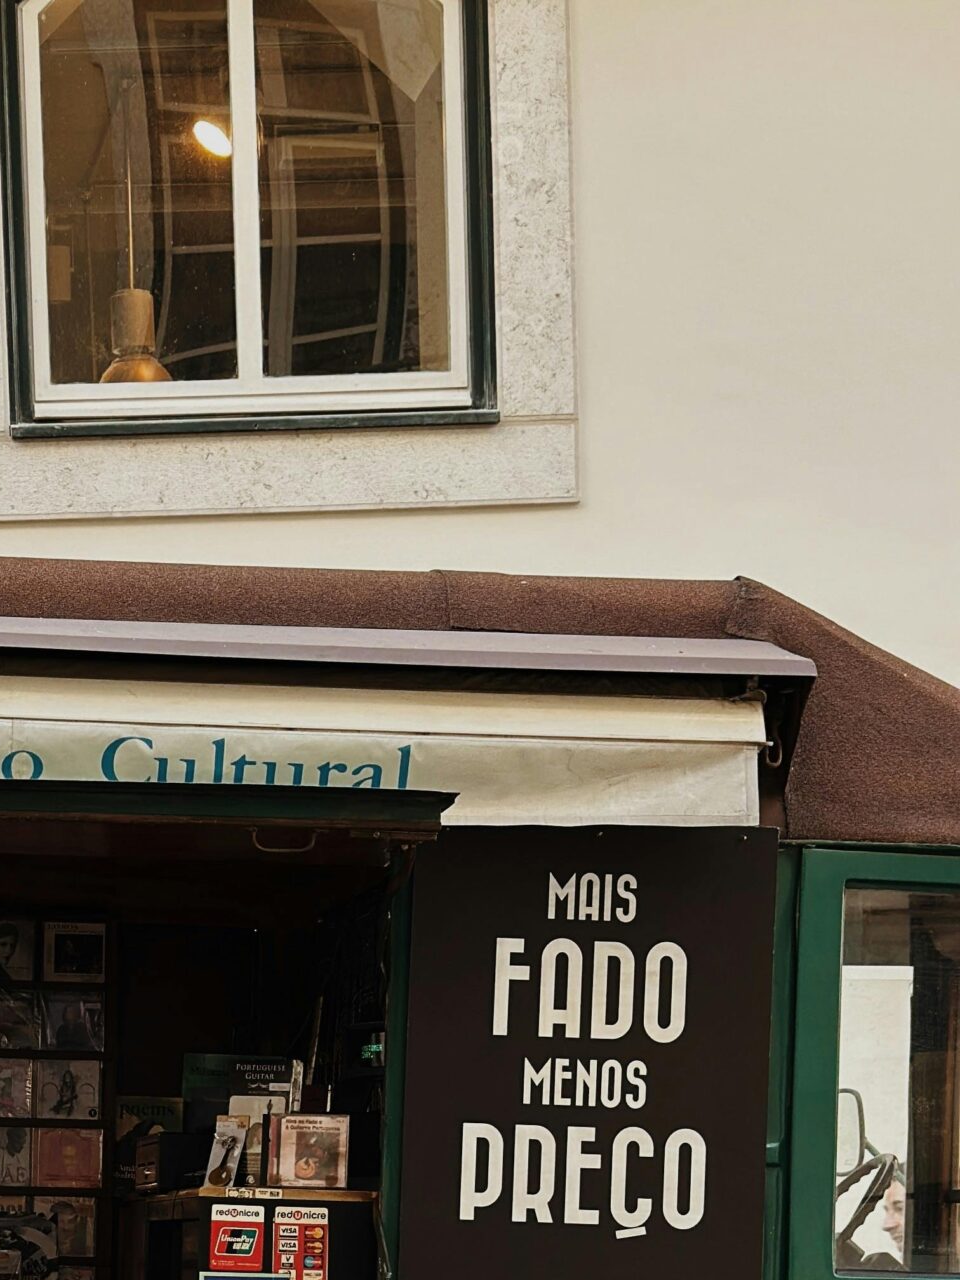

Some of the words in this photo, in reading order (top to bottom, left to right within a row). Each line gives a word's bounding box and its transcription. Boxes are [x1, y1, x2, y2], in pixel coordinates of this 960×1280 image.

[101, 736, 412, 789] Cultural
[547, 872, 638, 923] MAIS
[492, 937, 688, 1044] FADO
[236, 1063, 286, 1072] PORTUGUESE
[245, 1072, 275, 1080] GUITAR
[522, 1057, 647, 1109] MENOS
[459, 1122, 707, 1240] PREÇO
[221, 1234, 254, 1246] UnionPay
